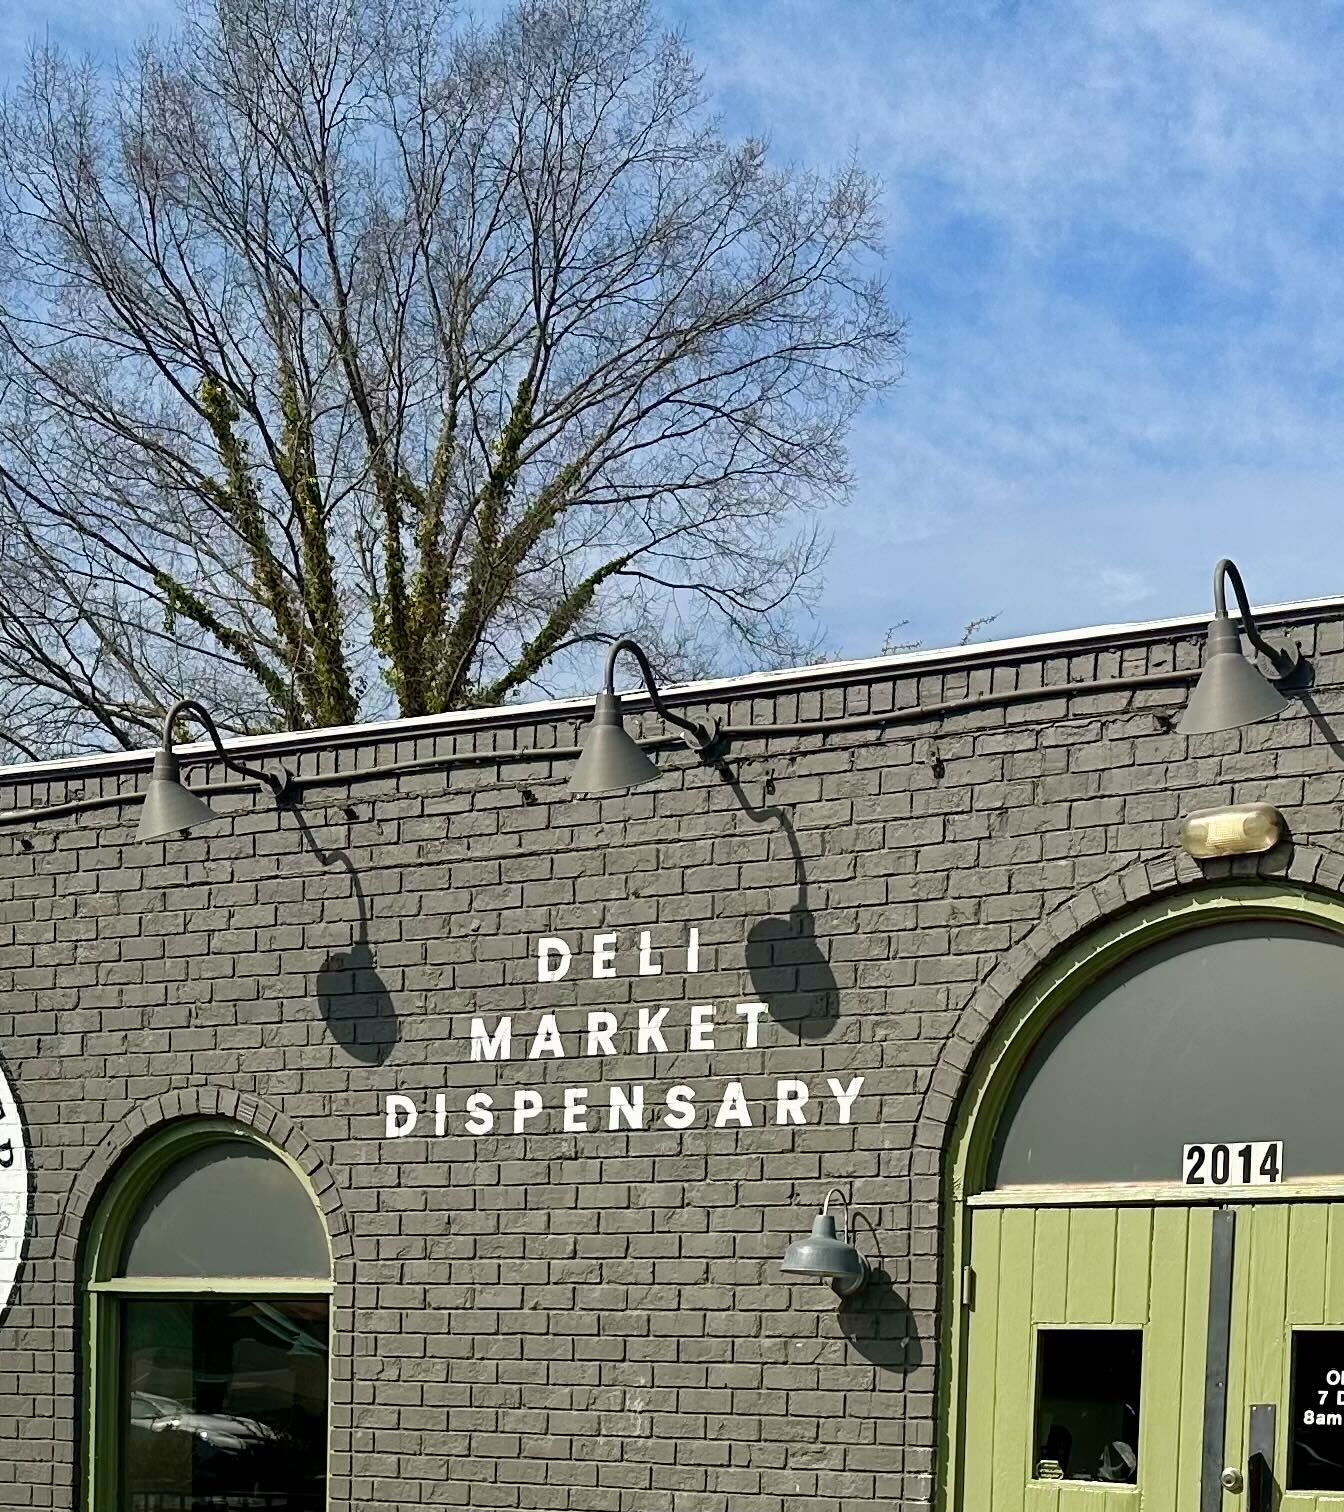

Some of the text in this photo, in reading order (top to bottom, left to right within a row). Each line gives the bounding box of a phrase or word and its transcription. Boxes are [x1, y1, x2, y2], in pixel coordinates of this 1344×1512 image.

[537, 927, 699, 982] DELI
[470, 1002, 769, 1062] MARKET
[385, 1077, 865, 1138] DISPENSARY
[1186, 1143, 1280, 1185] 2014
[1317, 1390, 1329, 1406] 7
